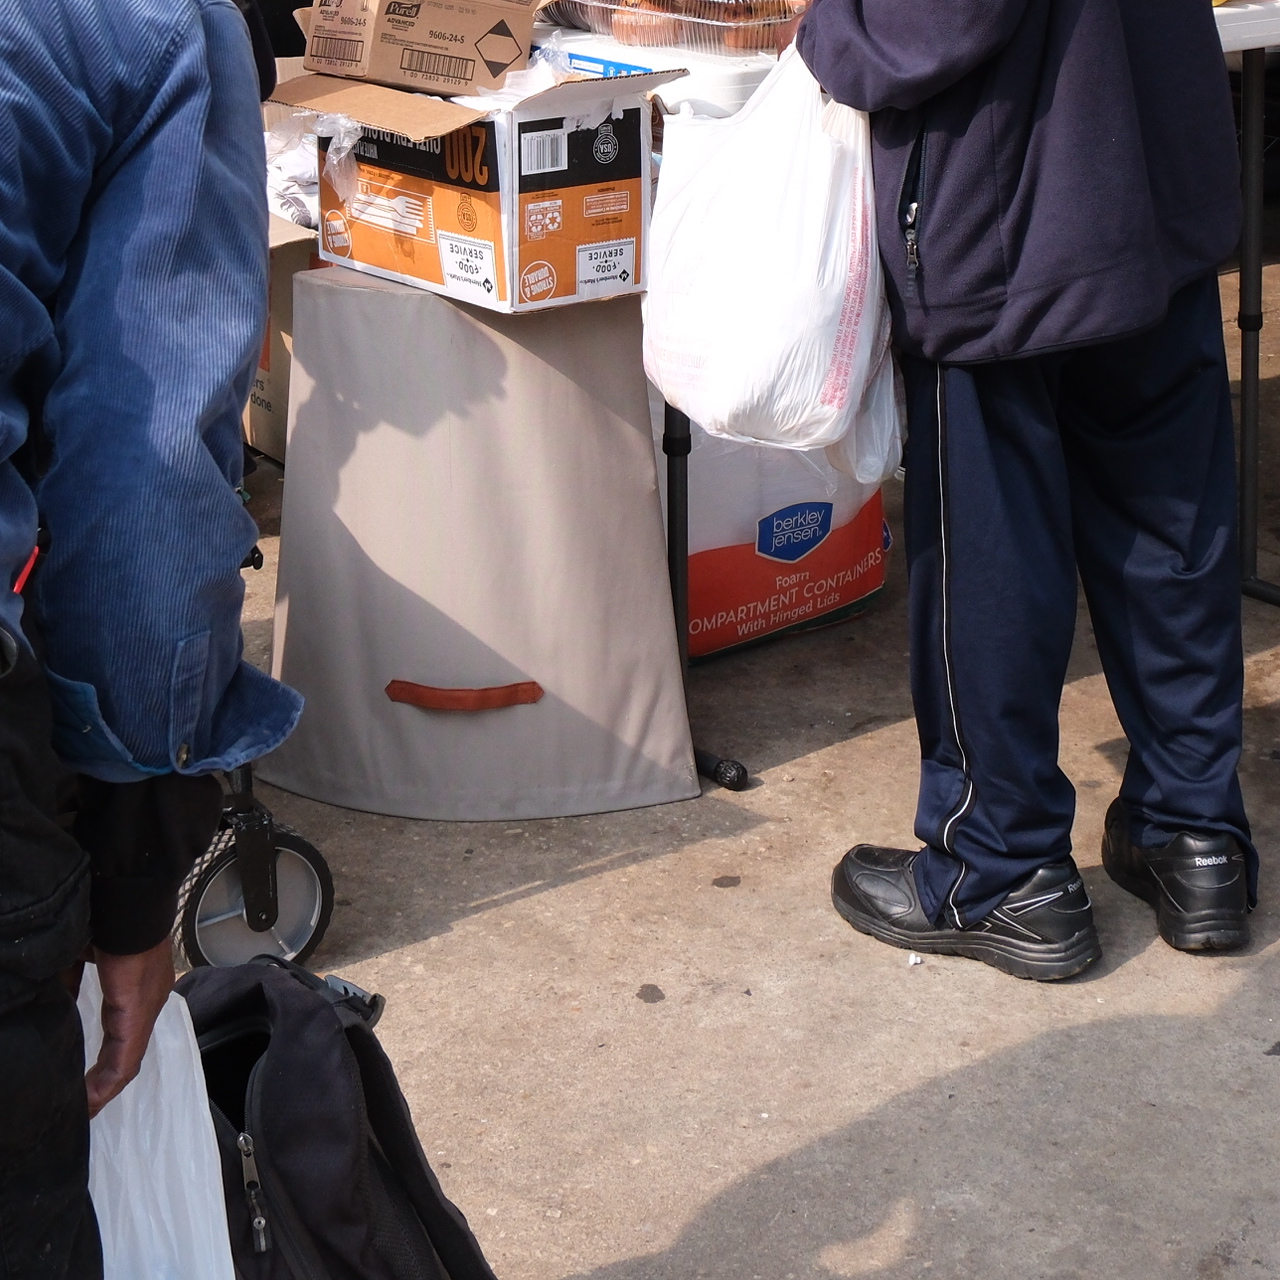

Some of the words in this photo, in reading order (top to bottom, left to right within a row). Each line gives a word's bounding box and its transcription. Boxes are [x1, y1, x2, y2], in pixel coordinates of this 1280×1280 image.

[387, 18, 415, 27] ADVANCED
[429, 30, 465, 44] 9606-24-S
[445, 126, 488, 186] 200
[449, 243, 484, 260] SERVICE
[588, 248, 624, 261] SERVICE
[458, 260, 478, 275] FOOD
[595, 261, 617, 273] FOOD
[523, 266, 549, 286] DURABLE
[531, 277, 553, 294] STRONG
[773, 509, 825, 533] berkley
[776, 571, 810, 590] Foam
[689, 588, 799, 636] OMPARTMENT
[803, 547, 883, 598] CONTAINERS
[737, 619, 766, 636] With
[770, 602, 813, 626] Hinged
[817, 591, 841, 608] Lids
